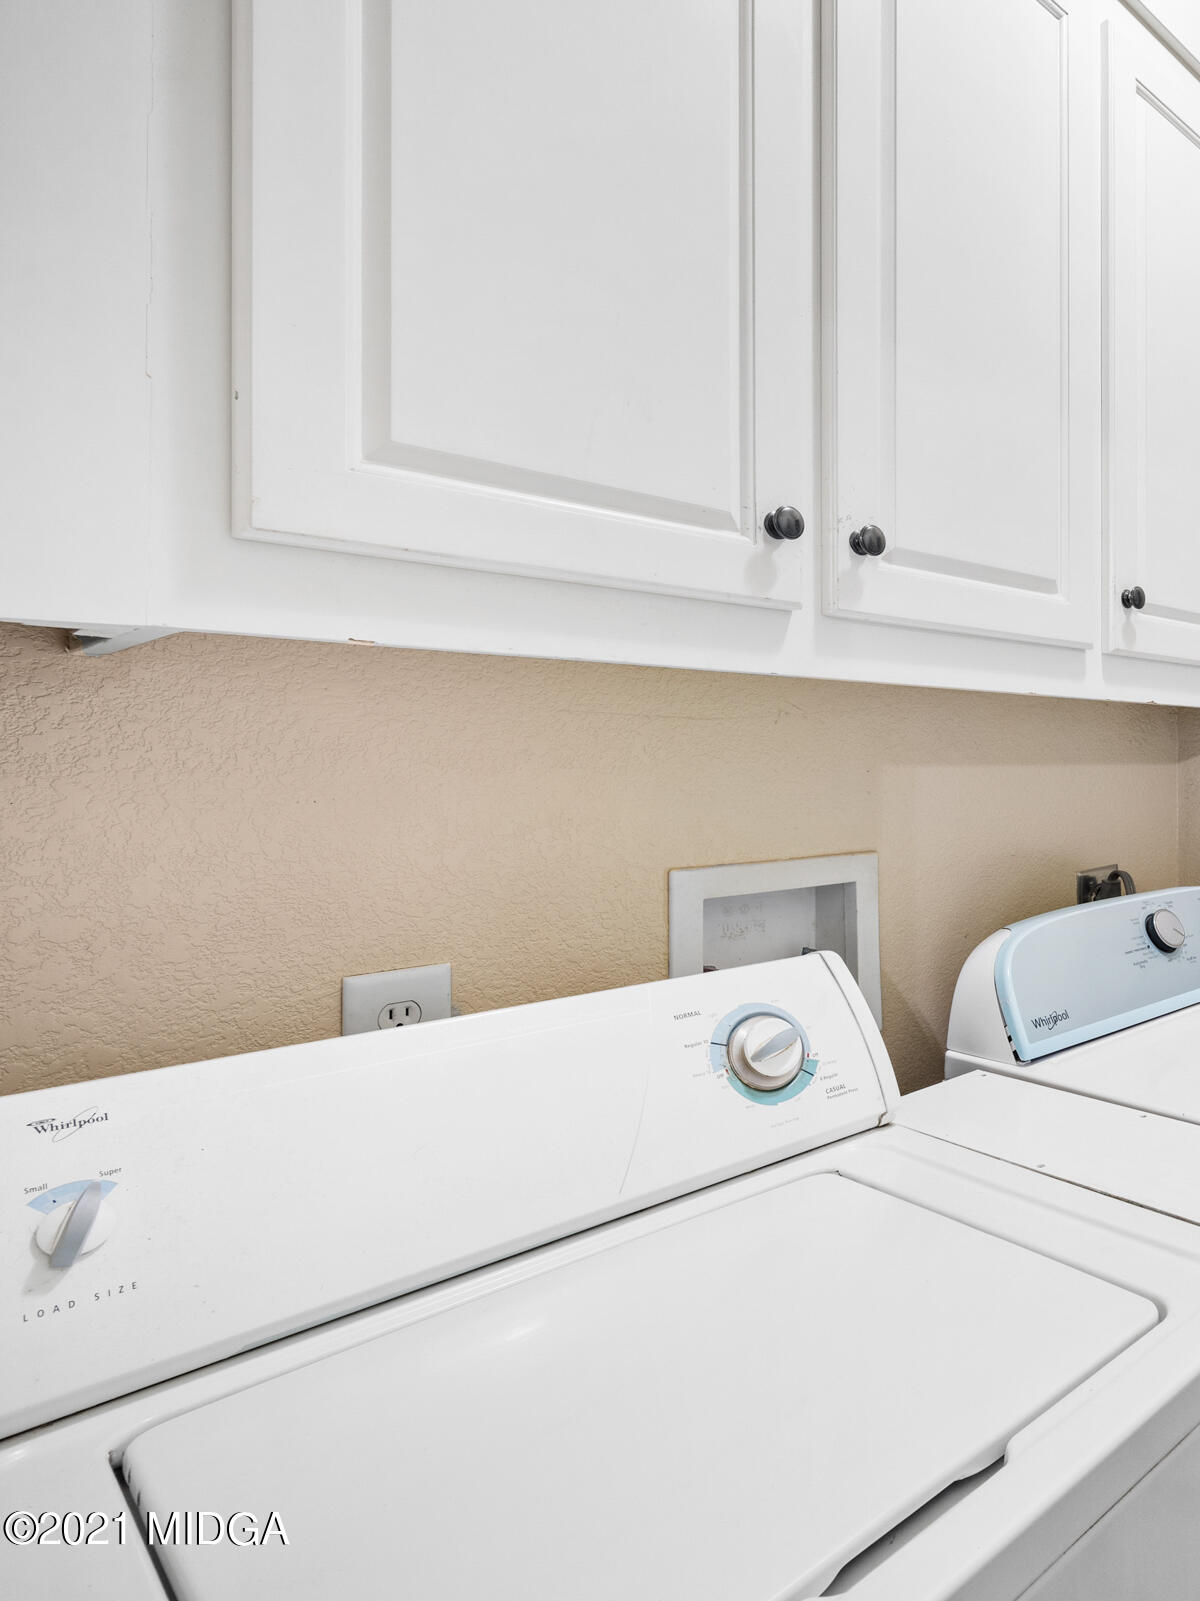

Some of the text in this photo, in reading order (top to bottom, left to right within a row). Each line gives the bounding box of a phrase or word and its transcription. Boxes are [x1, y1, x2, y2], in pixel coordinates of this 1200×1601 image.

[673, 1009, 703, 1022] NORMAL
[1030, 1009, 1070, 1029] Whirlpool
[825, 1083, 847, 1095] CASUAL
[34, 1112, 109, 1136] Whirlpool
[99, 1167, 123, 1178] Super
[23, 1184, 49, 1195] Small
[23, 1281, 138, 1323] LOAD SIZE
